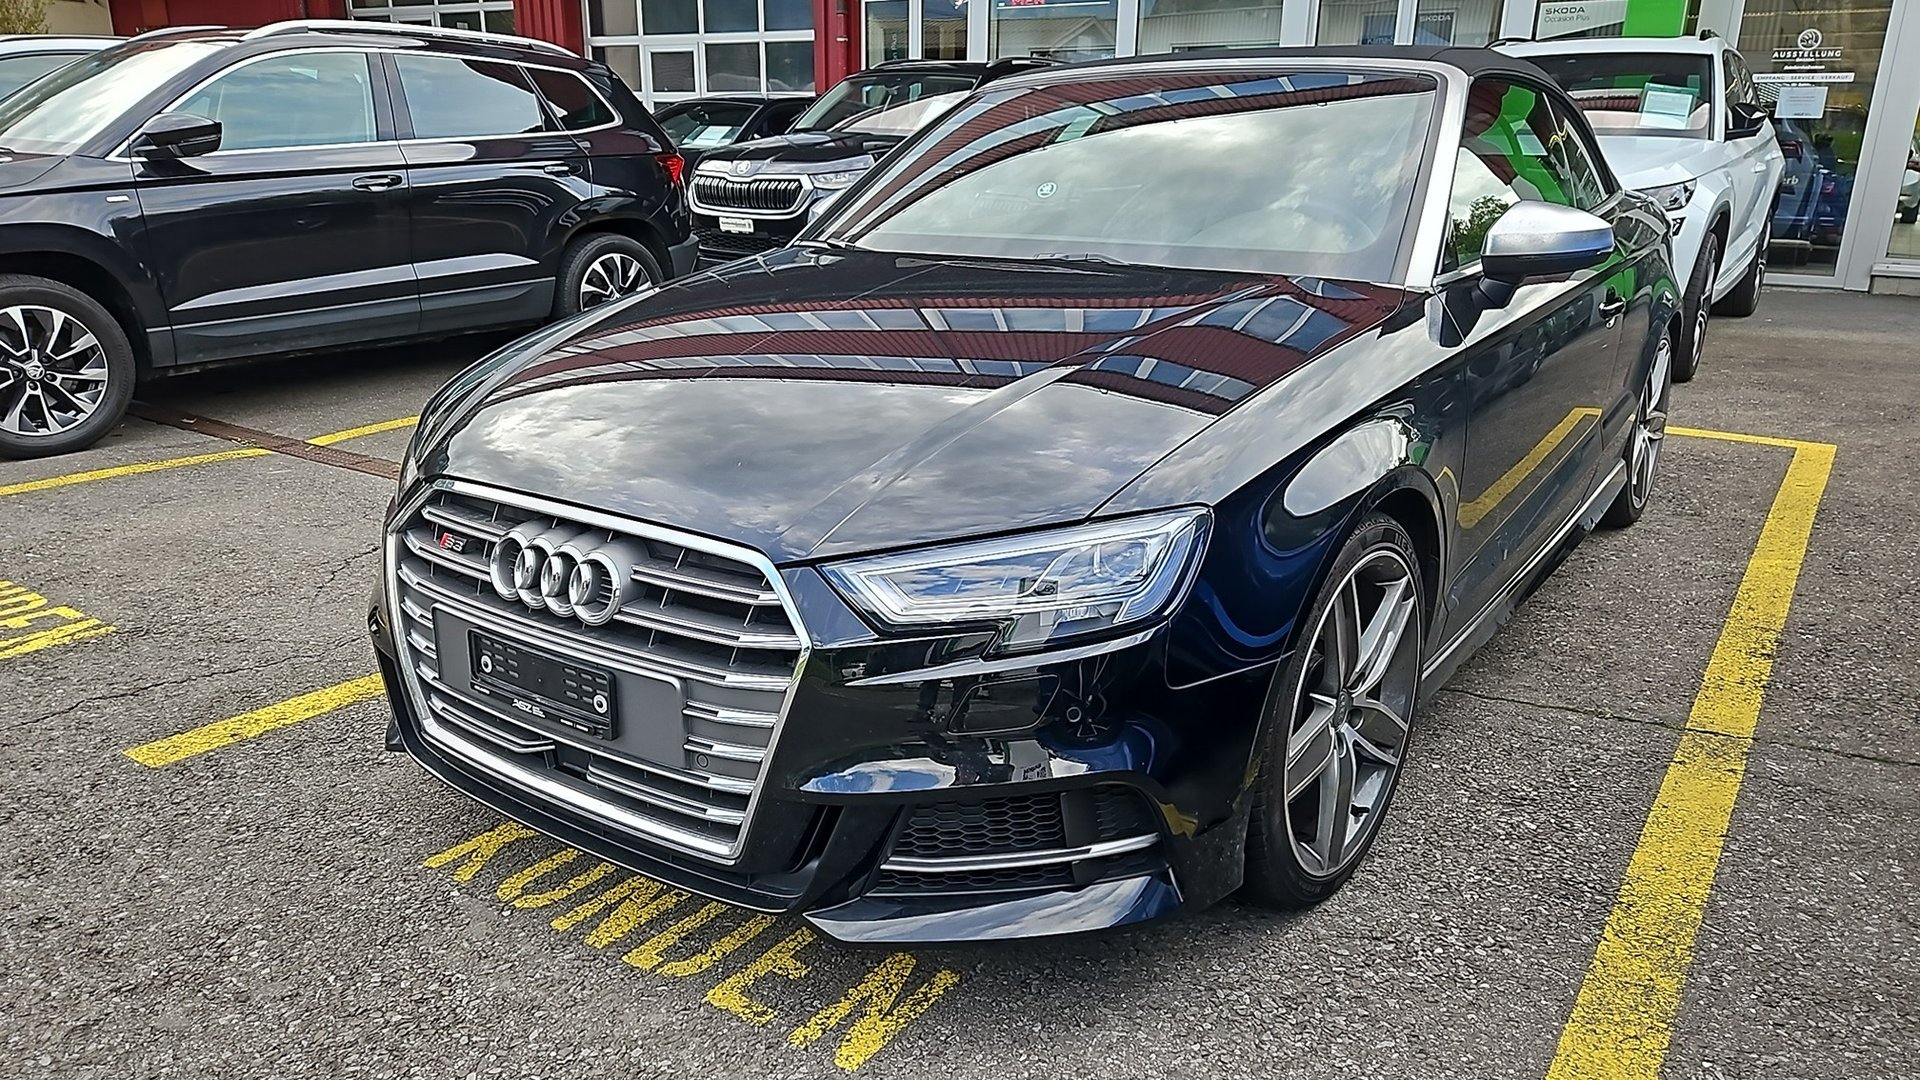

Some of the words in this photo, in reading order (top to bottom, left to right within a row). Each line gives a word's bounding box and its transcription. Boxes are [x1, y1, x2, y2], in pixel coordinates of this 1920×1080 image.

[1772, 49, 1842, 58] AUSSTELLUNG
[441, 533, 466, 551] S3
[422, 820, 961, 1072] KUNDEN
